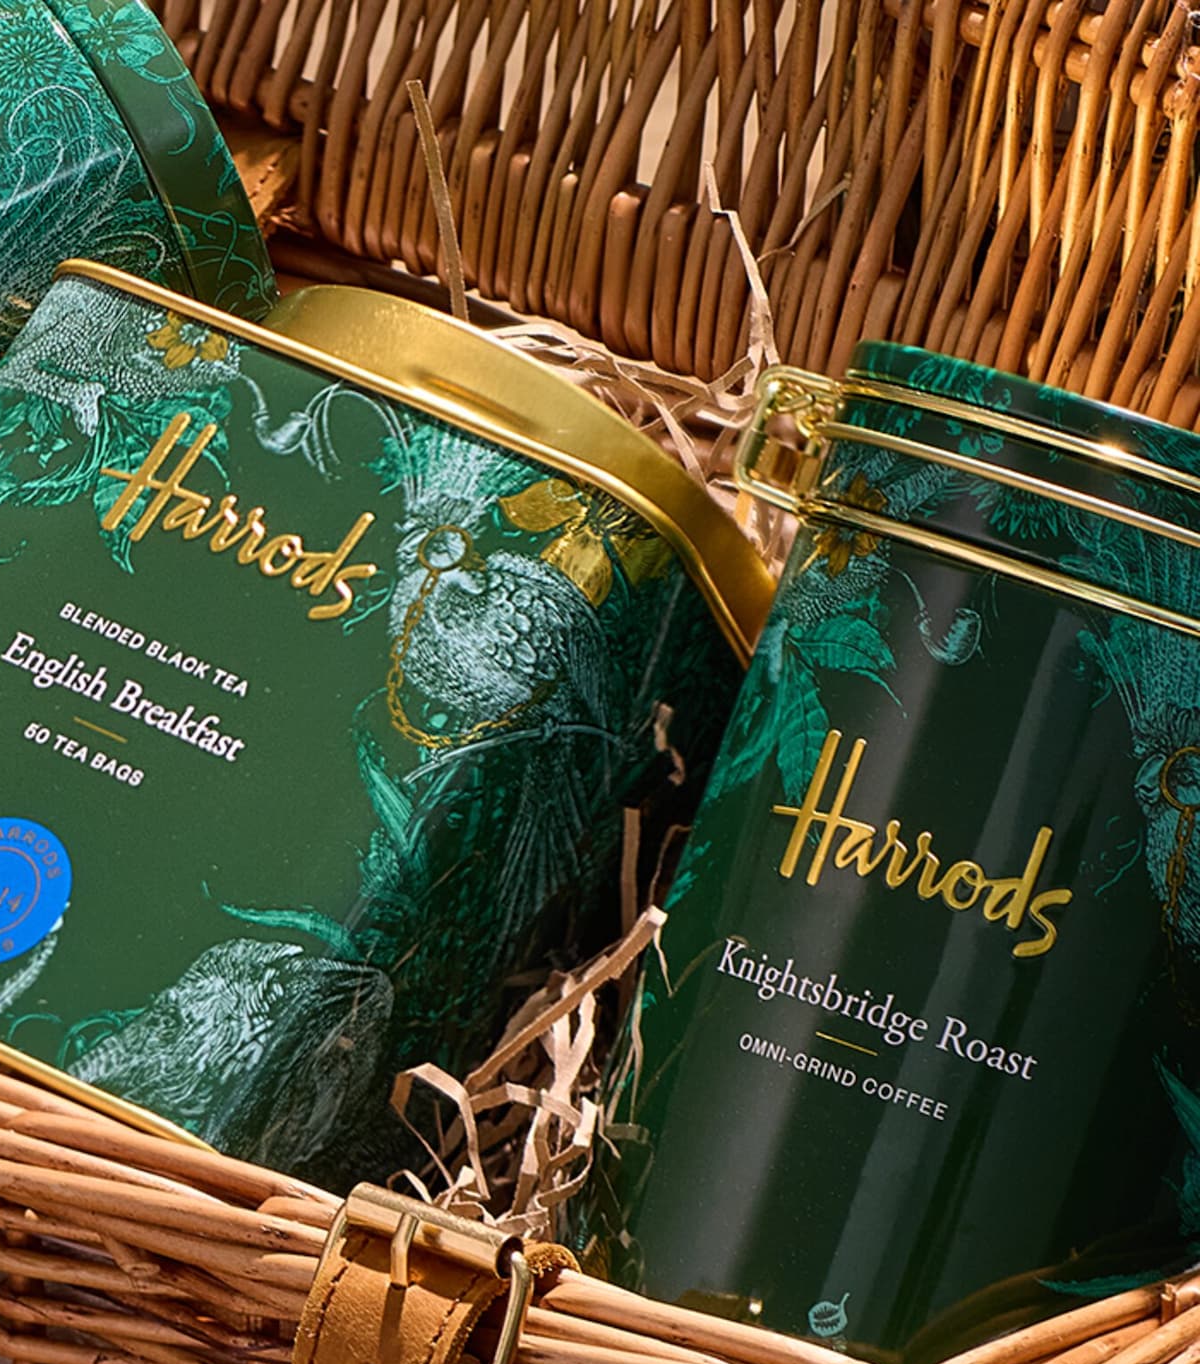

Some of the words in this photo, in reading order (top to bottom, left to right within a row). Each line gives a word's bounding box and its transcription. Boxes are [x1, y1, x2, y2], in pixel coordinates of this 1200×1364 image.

[100, 412, 377, 620] Harrods
[1, 632, 107, 702] English
[111, 679, 245, 762] Breakfast
[60, 602, 145, 652] BLENDED
[147, 640, 211, 681] BLACK
[211, 669, 250, 698] TEA
[54, 734, 89, 764] TEA
[90, 750, 145, 788] BAGS
[770, 728, 1073, 957] Harrods
[716, 937, 929, 1046] Knightsbridge
[936, 1016, 1039, 1081] Roast
[739, 1032, 857, 1088] OMNI-GRIND
[861, 1077, 949, 1121] COFFEE
